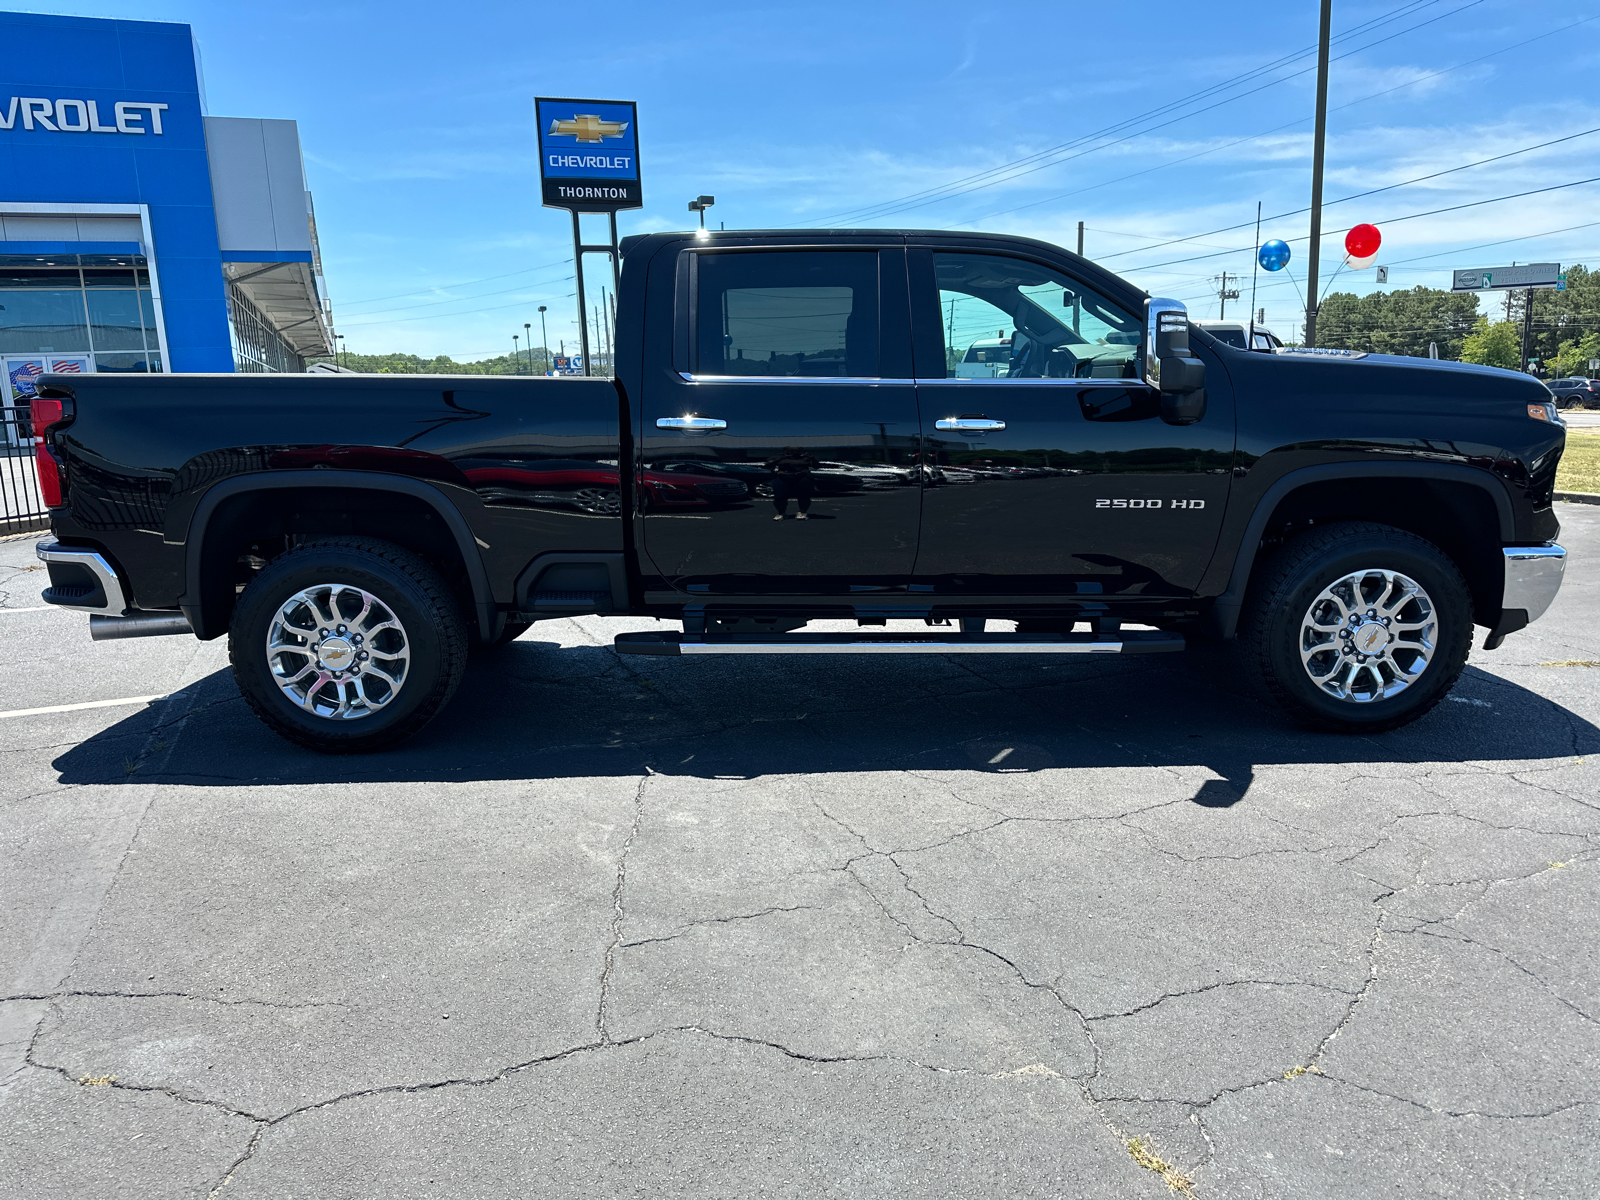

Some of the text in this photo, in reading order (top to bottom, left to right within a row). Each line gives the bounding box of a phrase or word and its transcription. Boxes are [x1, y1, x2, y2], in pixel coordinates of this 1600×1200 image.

[549, 155, 631, 169] CHEVROLET
[558, 186, 627, 199] THORNTON
[1479, 269, 1512, 279] CTIFIED
[1095, 498, 1205, 509] 2500 HD
